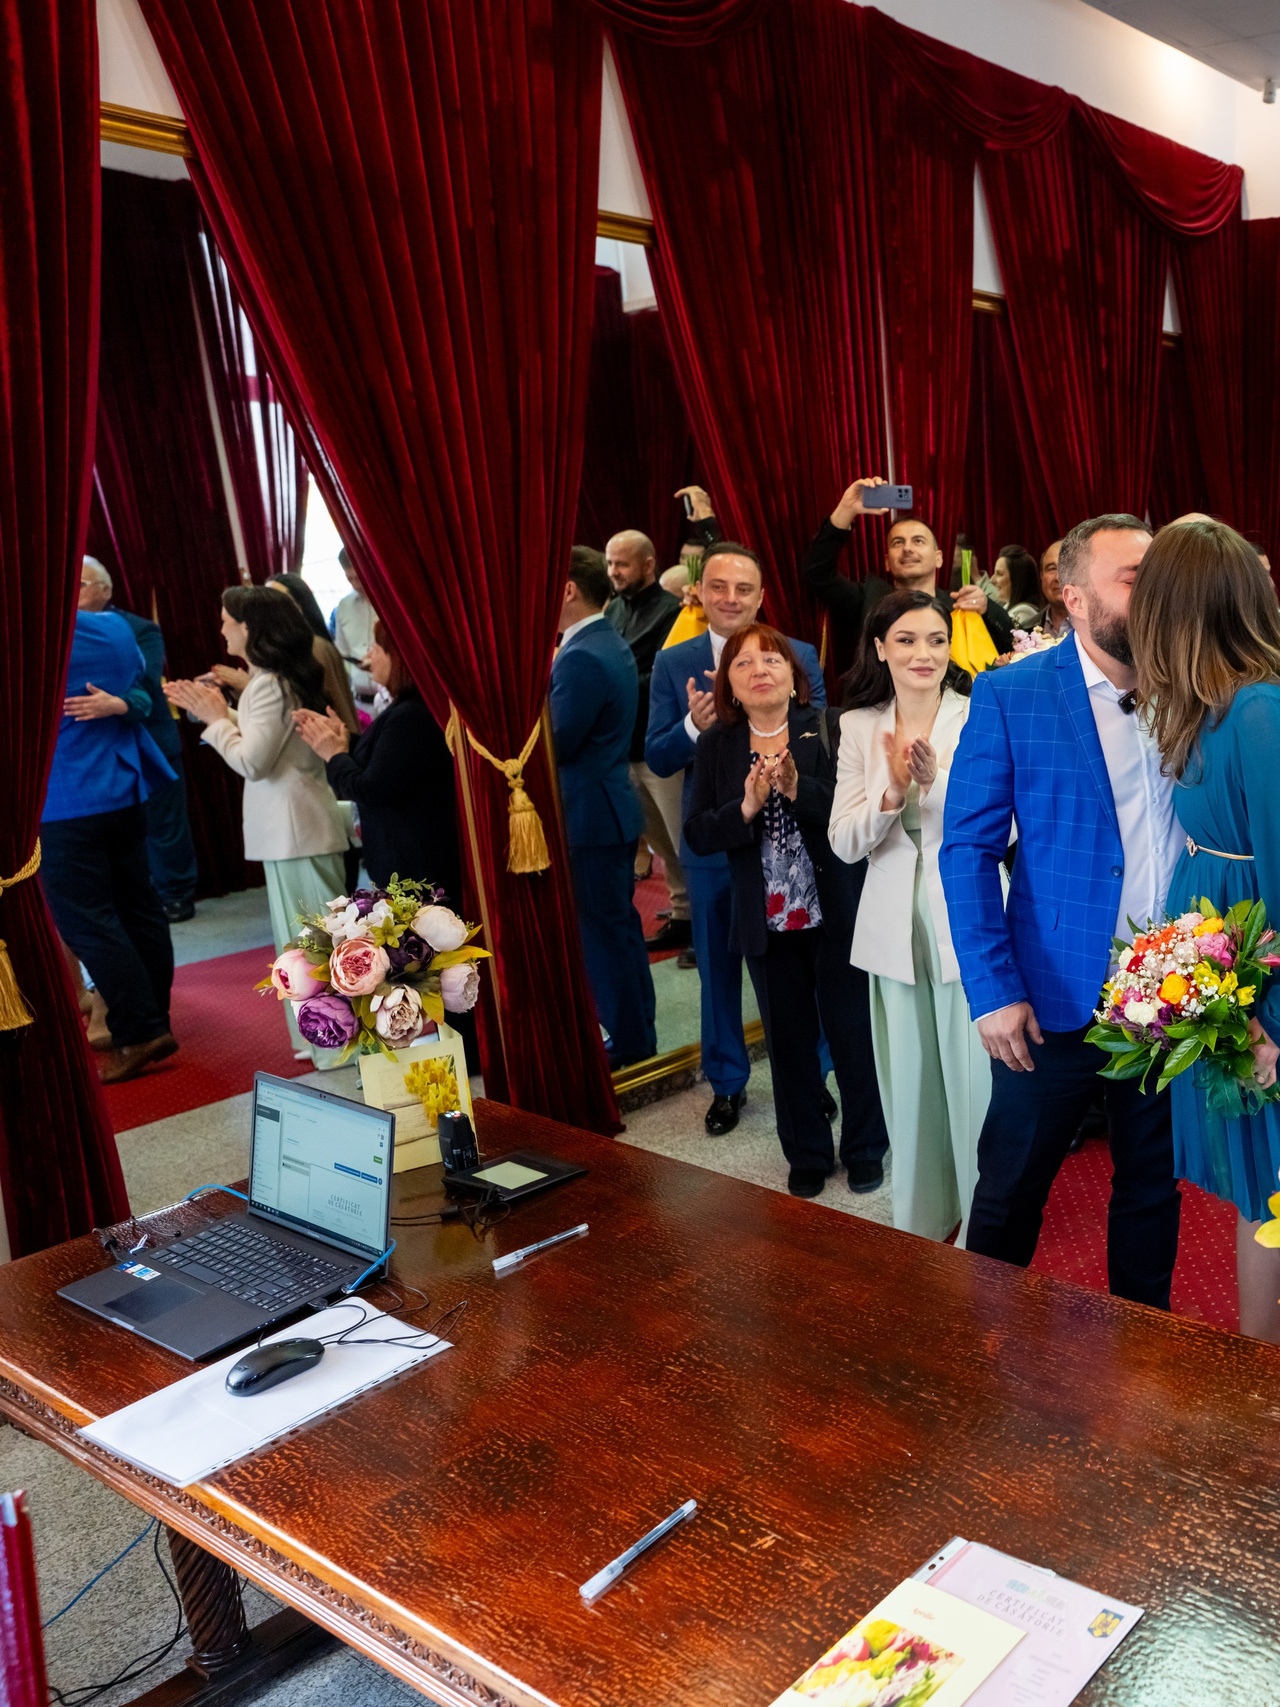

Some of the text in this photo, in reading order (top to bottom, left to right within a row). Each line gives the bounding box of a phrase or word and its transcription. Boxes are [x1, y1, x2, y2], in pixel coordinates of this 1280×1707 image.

[330, 1194, 361, 1210] CERTIFICAT
[976, 1594, 993, 1605] DE
[989, 1589, 1065, 1626] CERTIFICAT
